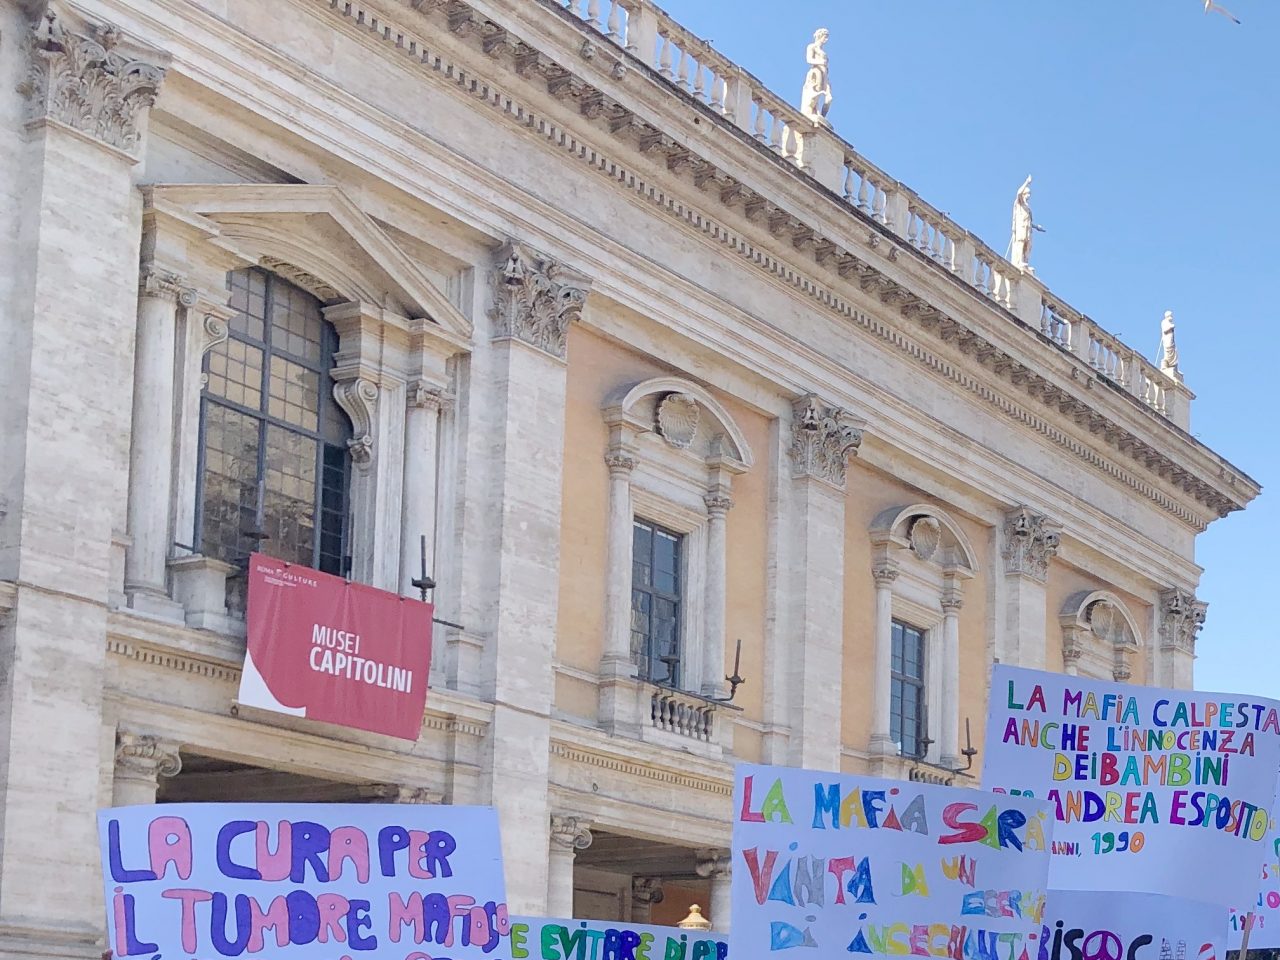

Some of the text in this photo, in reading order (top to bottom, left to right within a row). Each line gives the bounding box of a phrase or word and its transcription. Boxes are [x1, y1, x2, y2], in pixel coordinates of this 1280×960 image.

[312, 624, 360, 654] MUSEI
[310, 647, 412, 693] CAPITOLINI
[1003, 718, 1089, 750] ANCHE
[1007, 680, 1280, 735] LA MAFIA CALPESTA
[741, 775, 928, 835] LA MAFIA
[1048, 789, 1268, 841] ANDREA ESPOSITO
[109, 816, 456, 883] LA CURA PER
[1091, 832, 1145, 853] 1990
[743, 842, 976, 908] VINTA DA UN
[162, 889, 508, 956] TUMORE MAFIOSO
